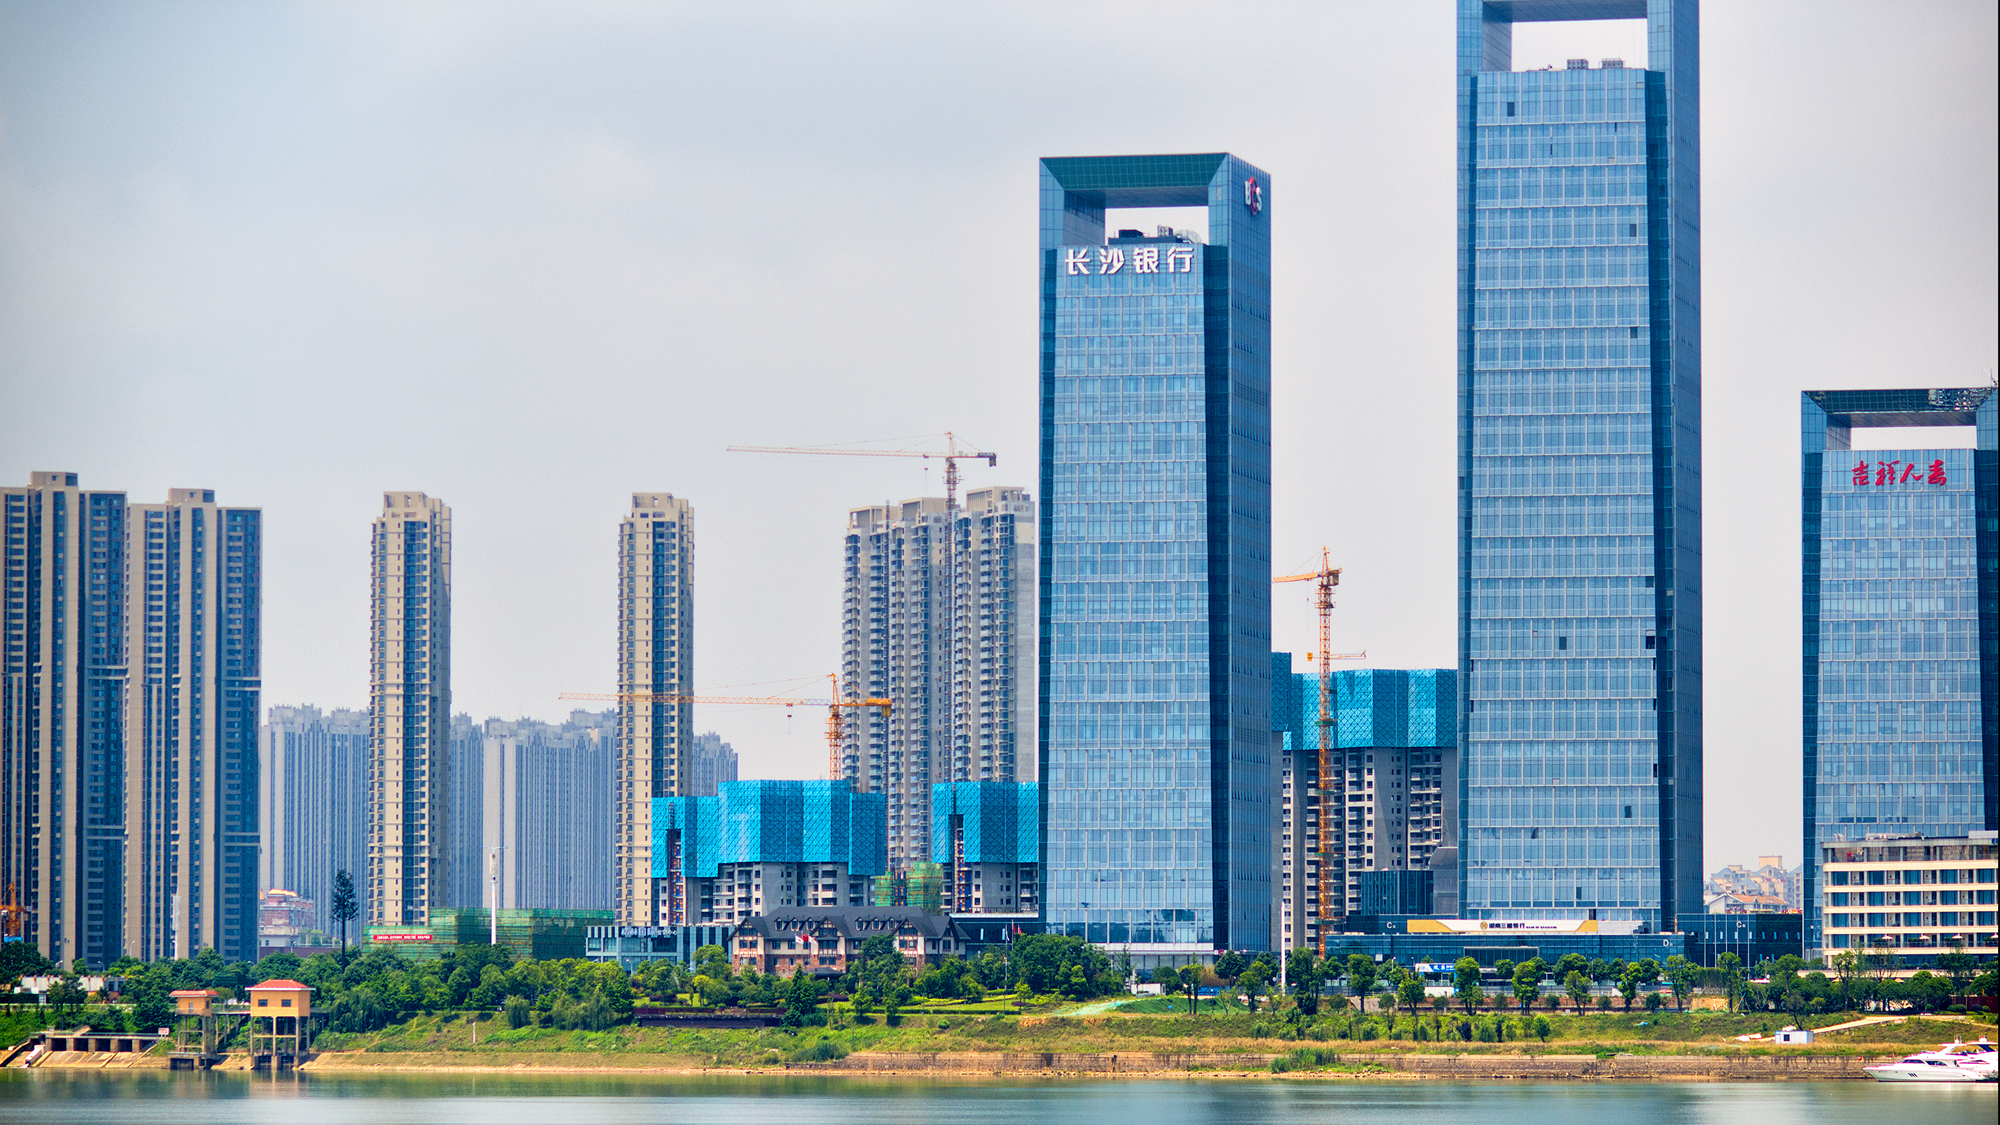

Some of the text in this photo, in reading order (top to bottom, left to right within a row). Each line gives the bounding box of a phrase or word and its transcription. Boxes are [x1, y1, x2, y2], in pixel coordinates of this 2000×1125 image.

[1064, 246, 1195, 275] 长沙银行
[1851, 459, 1947, 486] 吉祥人寿
